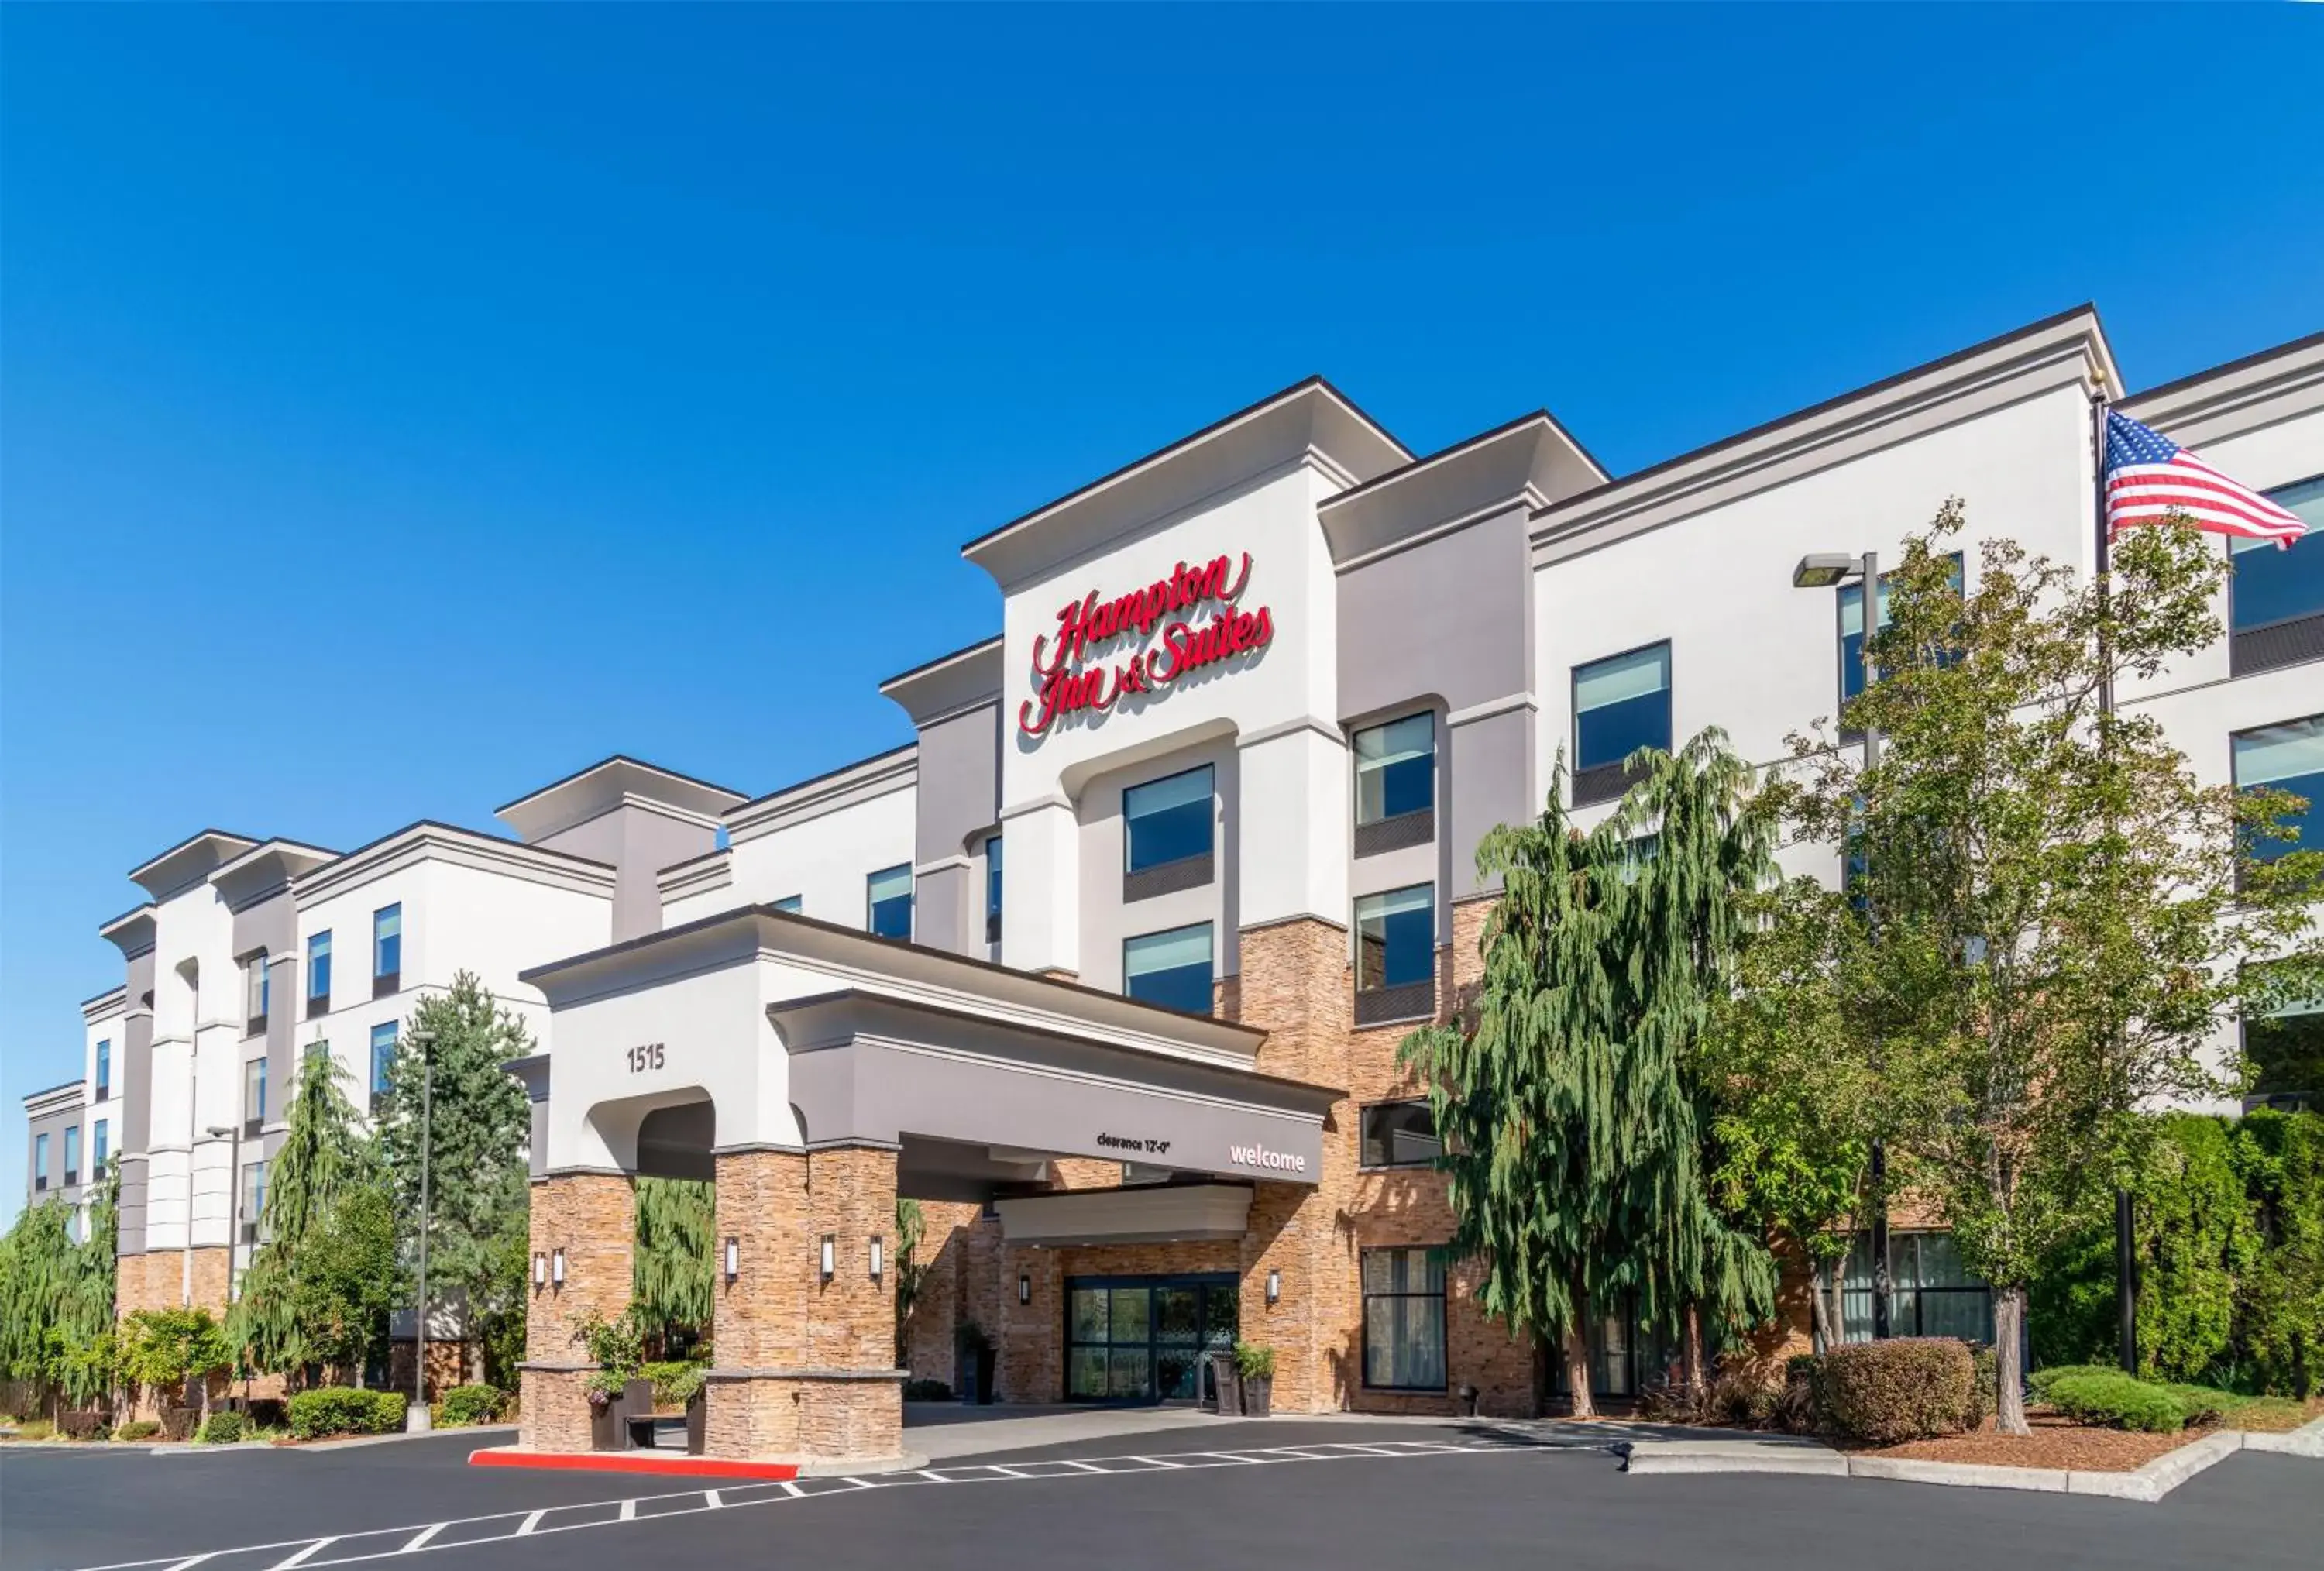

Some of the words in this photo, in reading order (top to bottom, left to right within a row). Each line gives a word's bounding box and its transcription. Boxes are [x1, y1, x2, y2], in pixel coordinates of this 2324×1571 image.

[1033, 551, 1253, 675] Hampton
[1019, 665, 1121, 734] Inn
[1121, 654, 1150, 693] &
[1147, 605, 1274, 682] Suites
[627, 1043, 664, 1073] 1515
[1097, 1132, 1143, 1152] clearance
[1229, 1143, 1305, 1173] welcome
